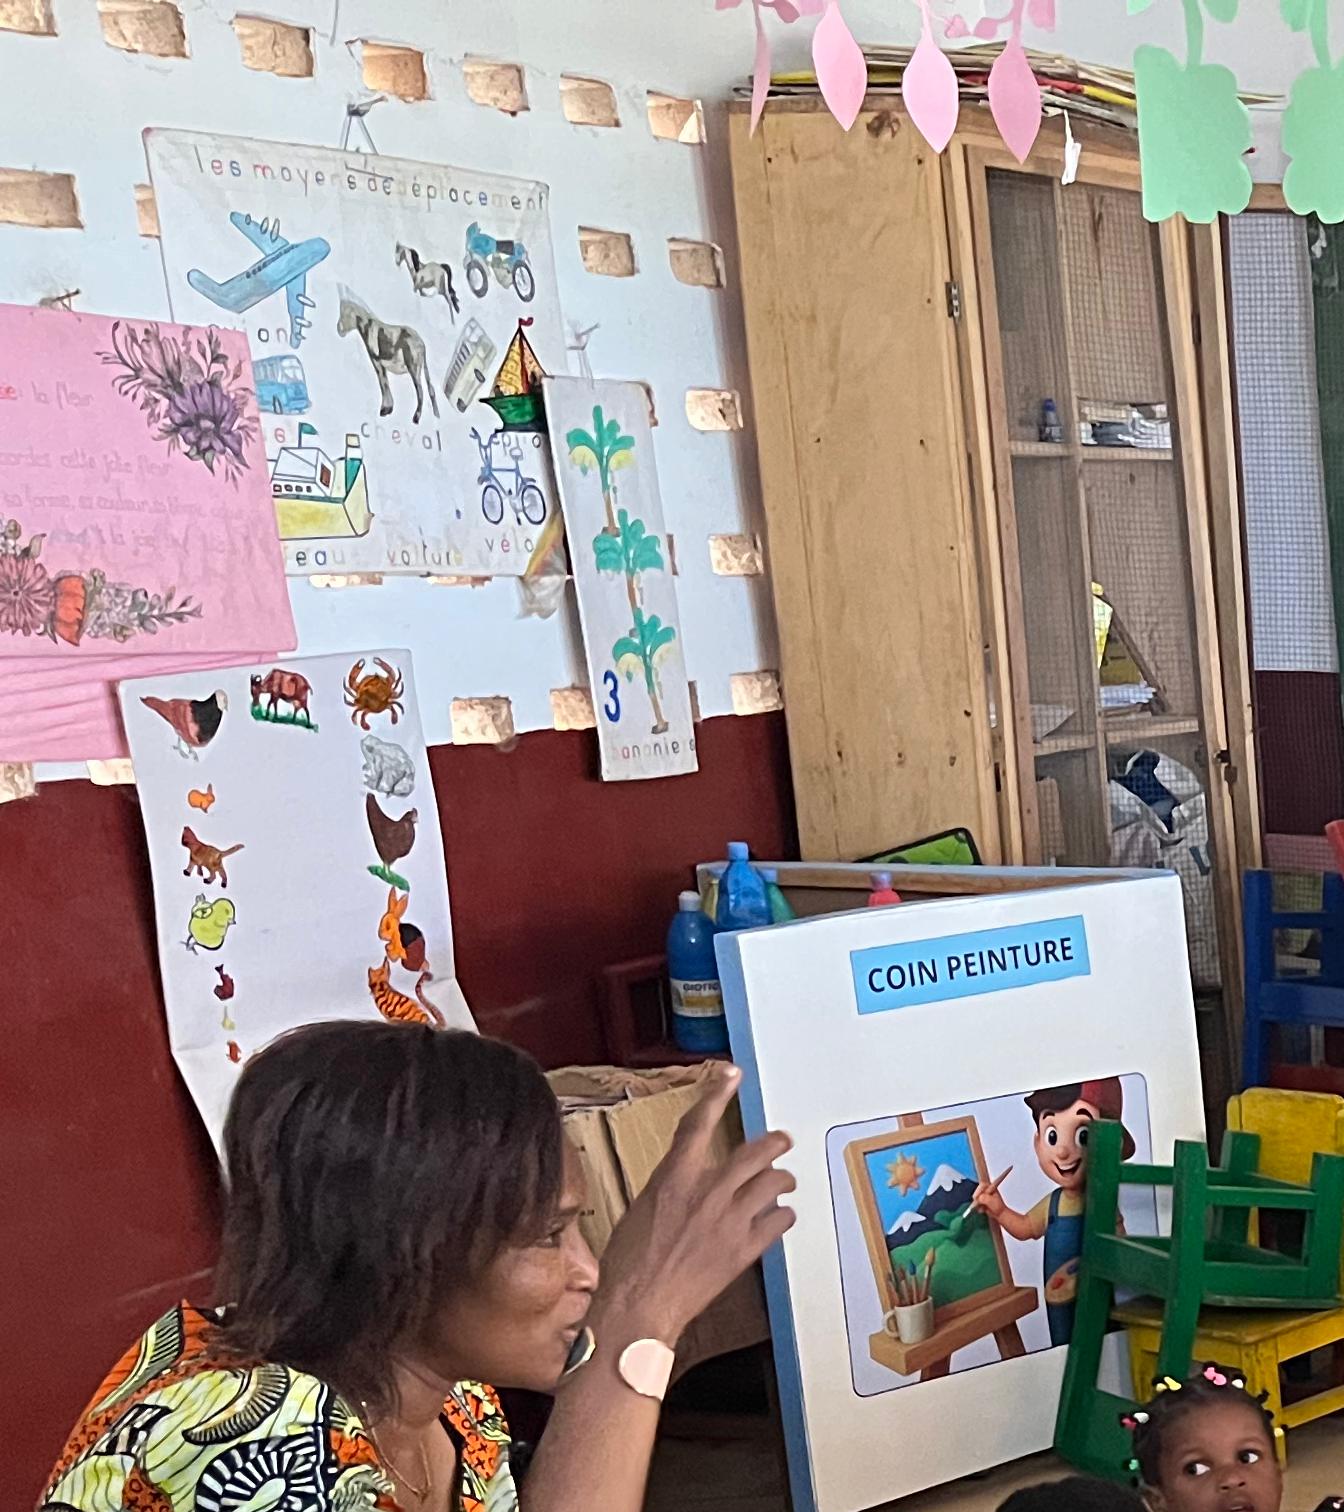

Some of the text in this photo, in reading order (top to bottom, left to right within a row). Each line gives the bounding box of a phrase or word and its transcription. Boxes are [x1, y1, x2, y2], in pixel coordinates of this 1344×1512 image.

[194, 144, 241, 177] les
[603, 670, 621, 723] 3
[868, 937, 1075, 993] COIN PEINTURE
